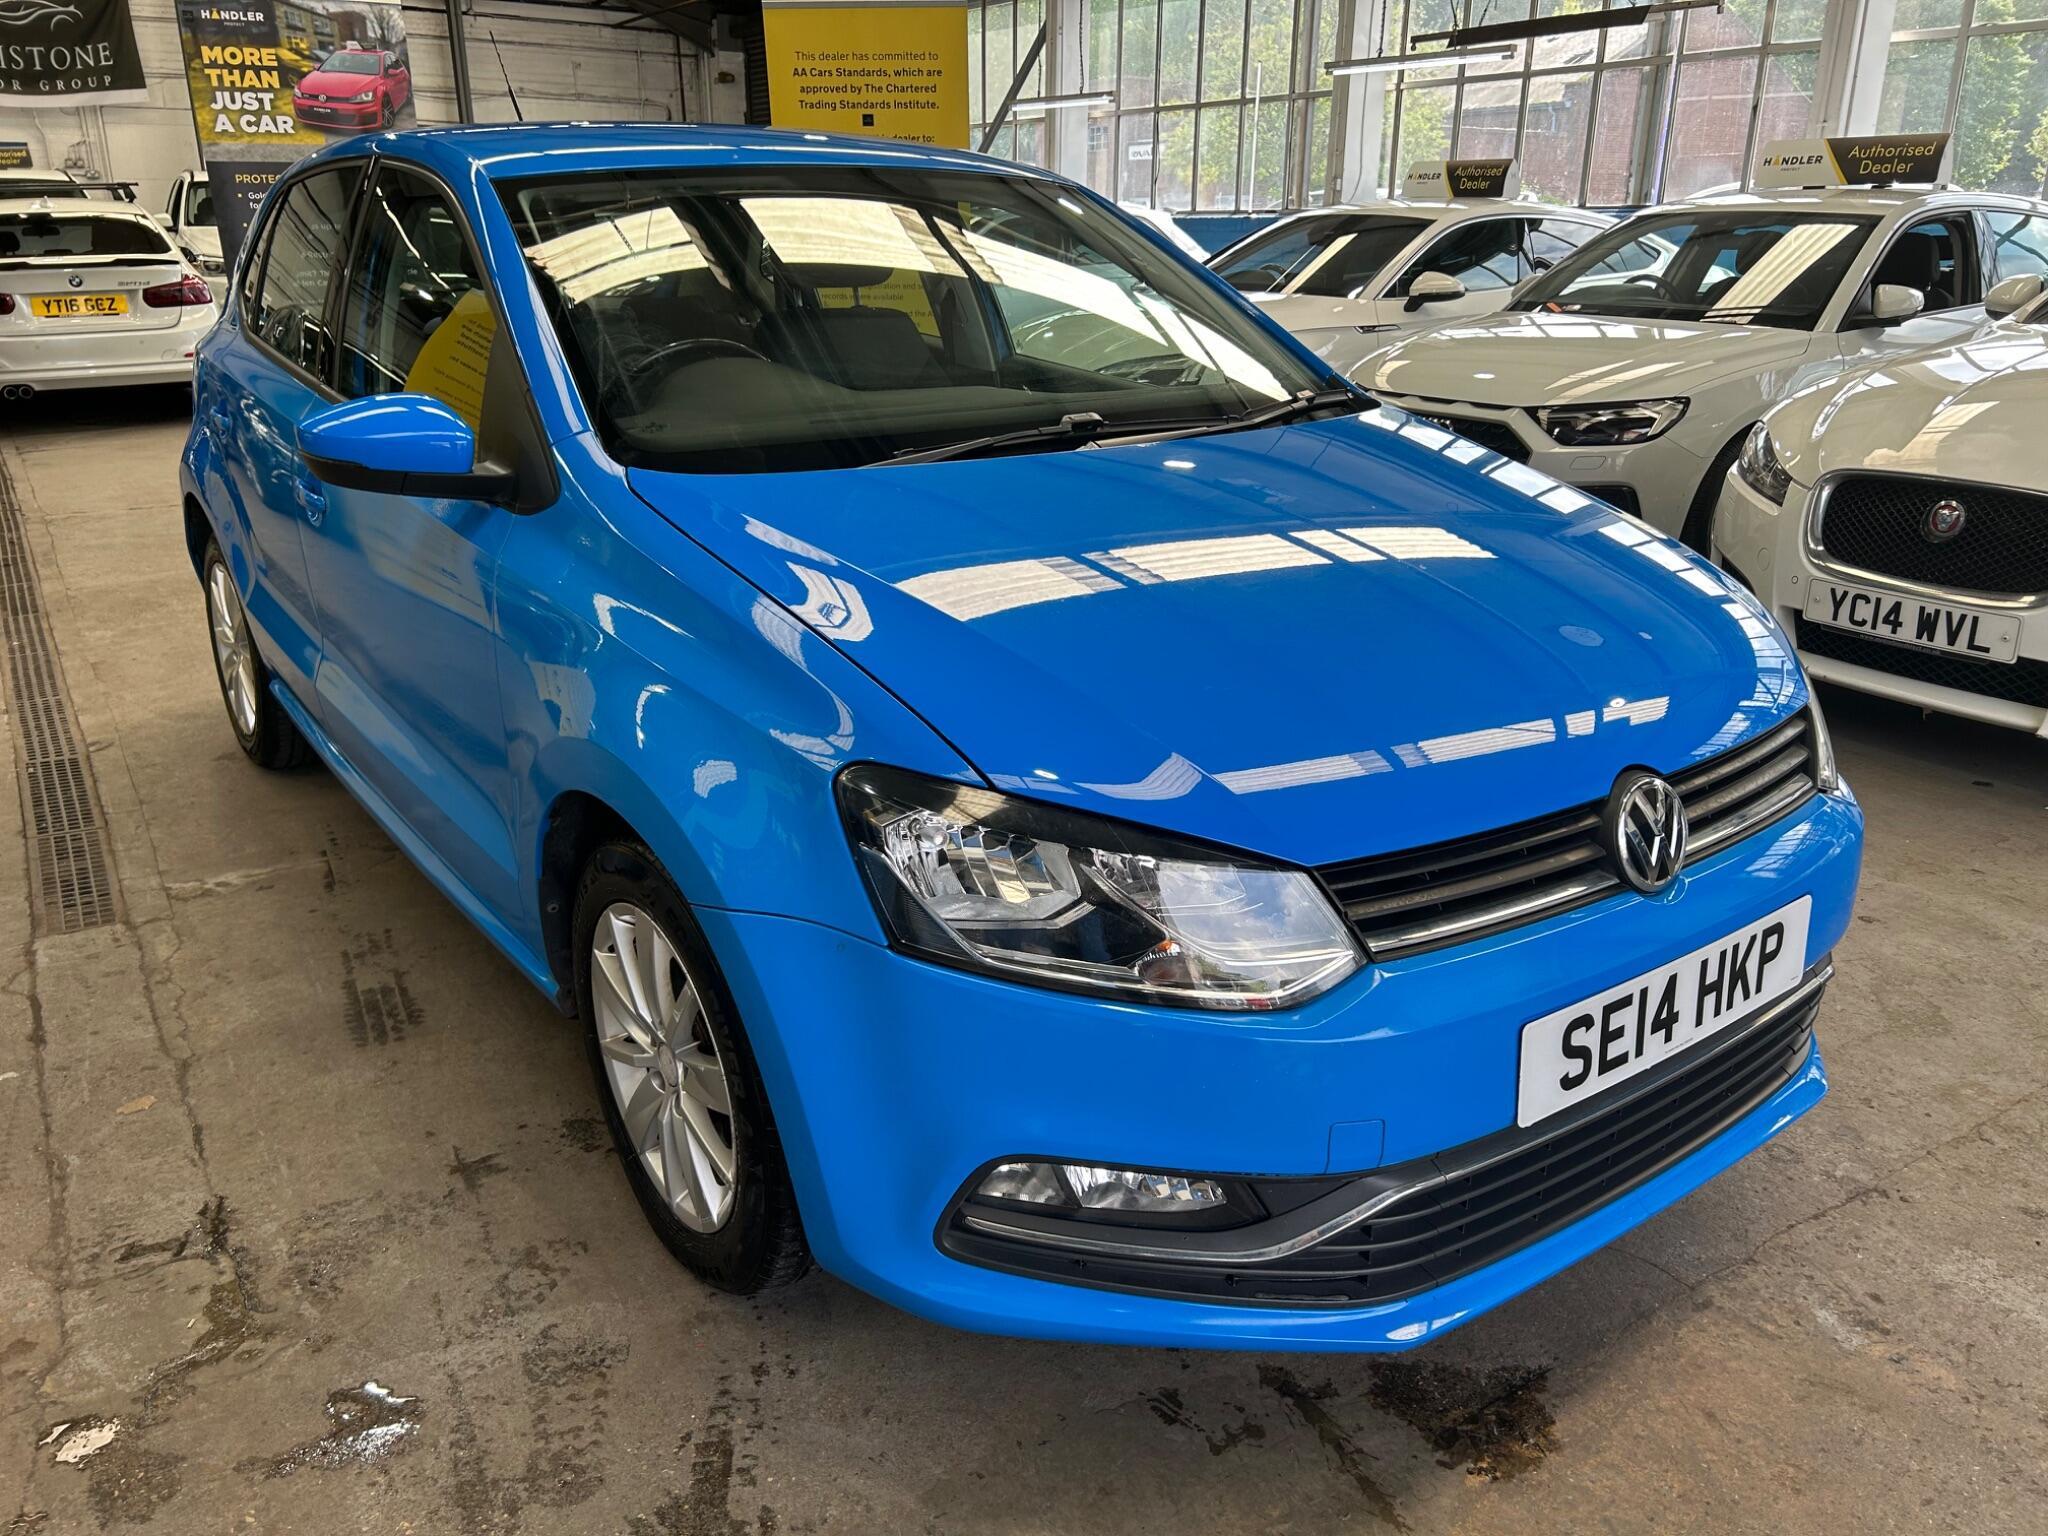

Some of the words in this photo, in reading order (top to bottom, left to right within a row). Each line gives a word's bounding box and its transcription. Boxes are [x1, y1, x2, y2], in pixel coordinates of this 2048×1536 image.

[201, 45, 278, 66] MORE
[795, 51, 816, 61] This
[818, 51, 850, 61] dealer
[852, 51, 869, 61] has
[872, 51, 926, 61] committed
[929, 52, 939, 61] to
[203, 68, 280, 88] THAN
[793, 67, 807, 77] AA
[810, 67, 833, 77] Cars
[836, 67, 891, 78] Standards,
[893, 67, 924, 77] which
[926, 69, 943, 77] are
[40, 75, 112, 91] GROUP
[799, 83, 848, 95] approved
[850, 83, 862, 95] by
[864, 83, 884, 93] The
[886, 83, 937, 93] Chartered
[210, 91, 274, 111] JUST
[799, 99, 837, 111] Trading
[839, 99, 891, 109] Standards
[893, 99, 940, 109] Institute.
[214, 113, 236, 132] A
[240, 114, 296, 134] CAR
[1848, 141, 1937, 159] Authorised
[1455, 164, 1504, 177] Authorised
[1859, 159, 1914, 175] Dealer
[1460, 178, 1490, 190] Dealer
[42, 298, 80, 313] YT16
[1830, 587, 1903, 635] YC14
[1915, 605, 1991, 654] WVL
[1559, 972, 1680, 1092] SE14
[1694, 921, 1785, 1028] HKP
